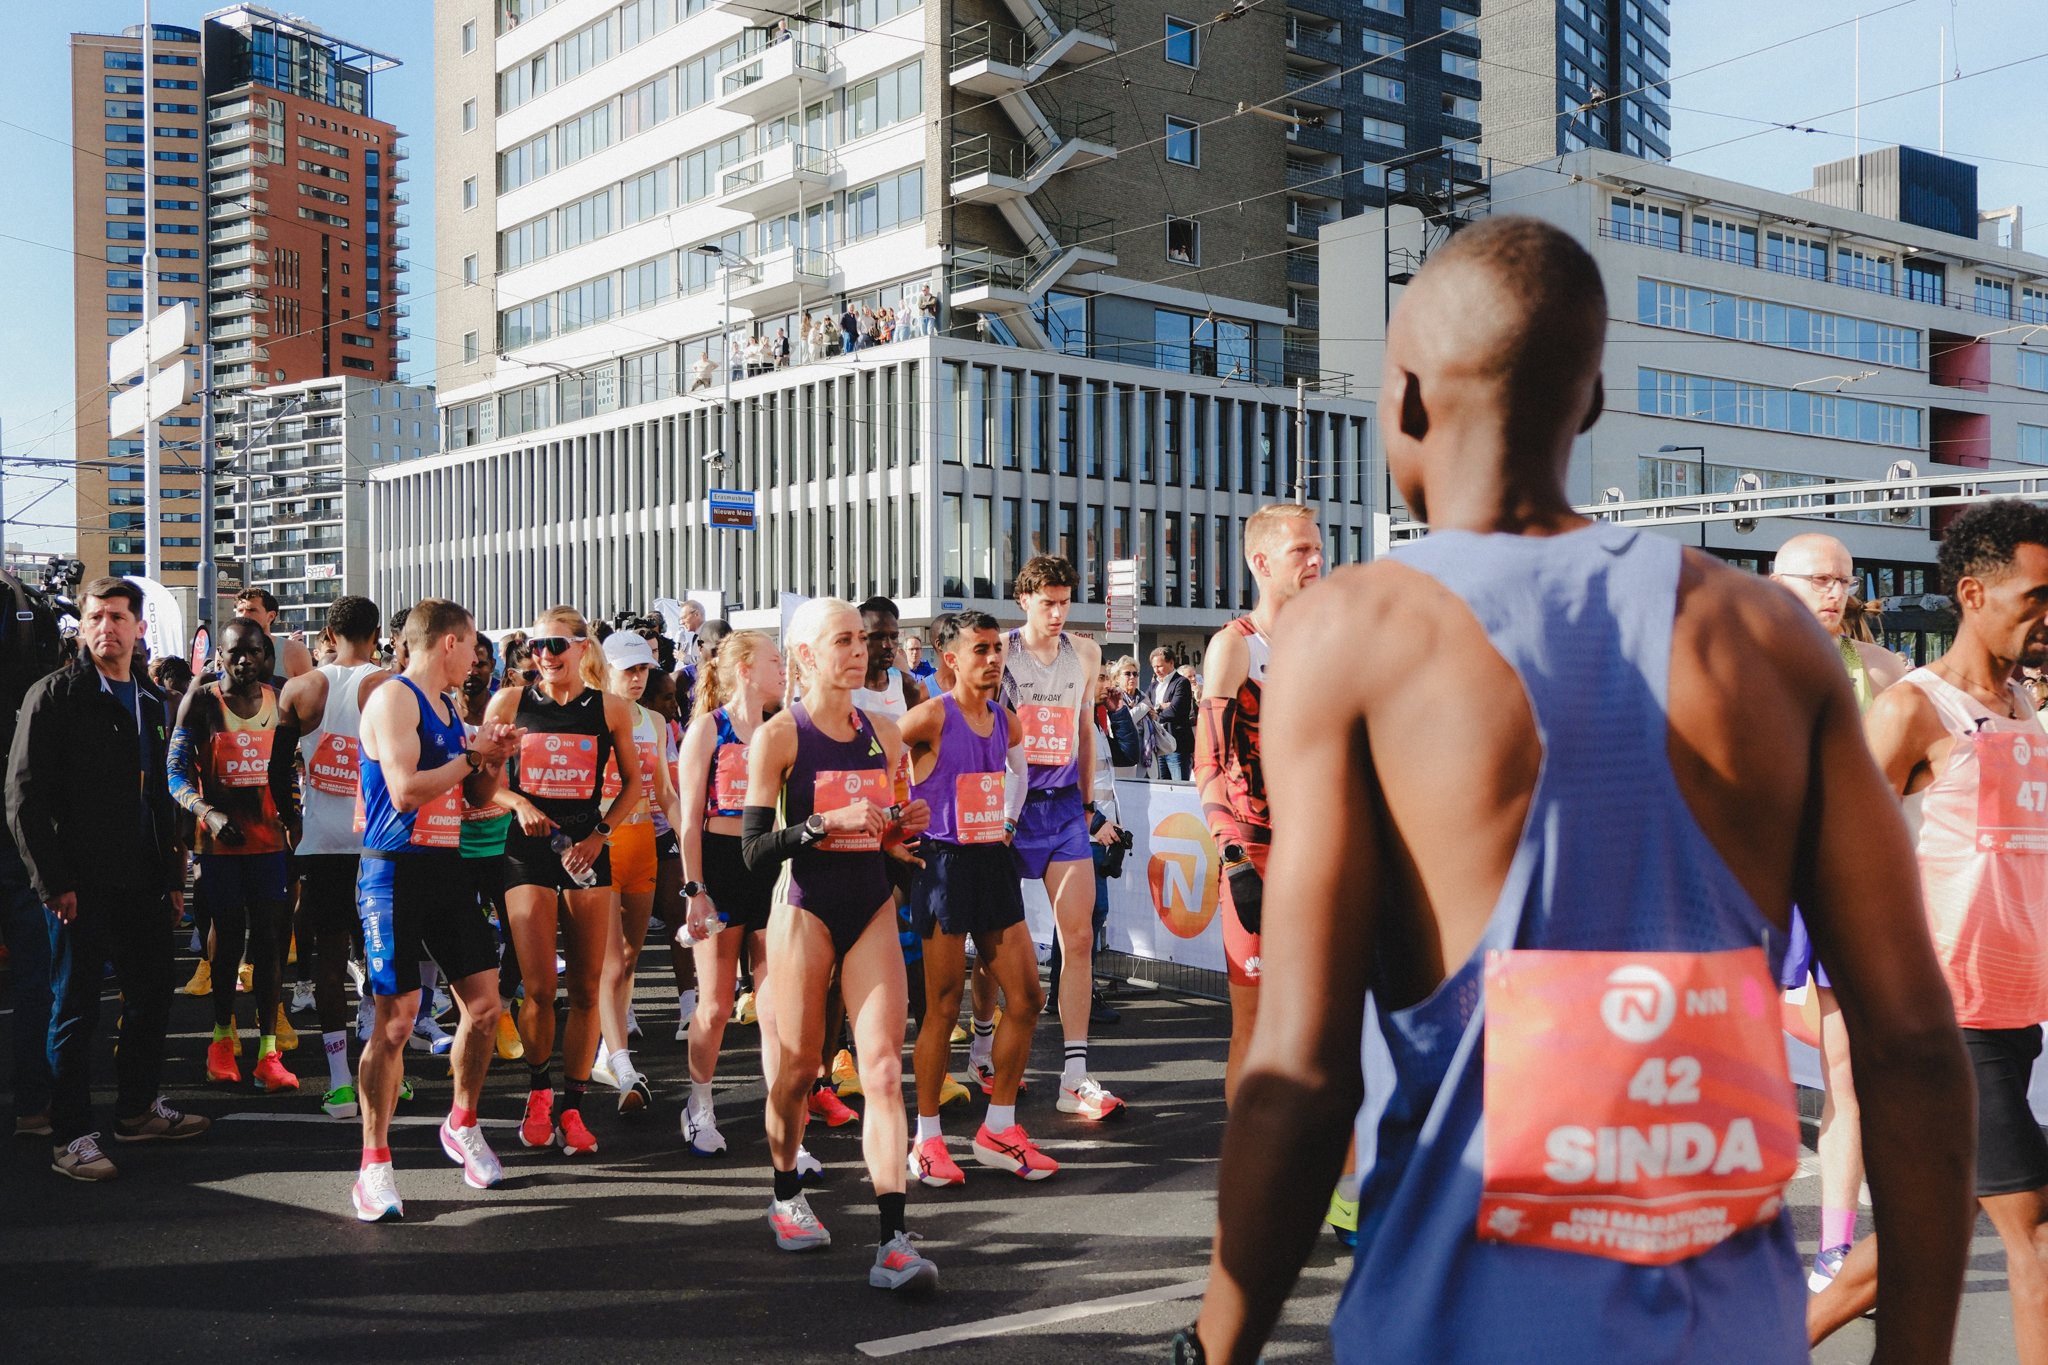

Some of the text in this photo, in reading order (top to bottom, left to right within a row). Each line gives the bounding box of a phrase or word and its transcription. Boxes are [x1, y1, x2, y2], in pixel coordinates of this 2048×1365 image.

[714, 493, 752, 503] Erasmusbrug
[713, 508, 753, 517] Nieuwe Maas
[1041, 724, 1055, 735] 66
[1024, 735, 1068, 750] PACE
[242, 749, 258, 758] 60
[335, 754, 349, 765] 18
[550, 754, 568, 765] F6
[527, 767, 591, 782] WARPY
[863, 778, 875, 786] NN
[986, 794, 998, 806] 33
[2016, 781, 2047, 812] 47
[445, 798, 456, 810] 43
[830, 842, 868, 850] ROTTERDAM
[1685, 988, 1728, 1016] NN
[1627, 1056, 1702, 1106] 42
[1543, 1117, 1764, 1183] SINDA
[1610, 1206, 1728, 1233] MARATHON
[1551, 1221, 1690, 1254] ROTTERDAM
